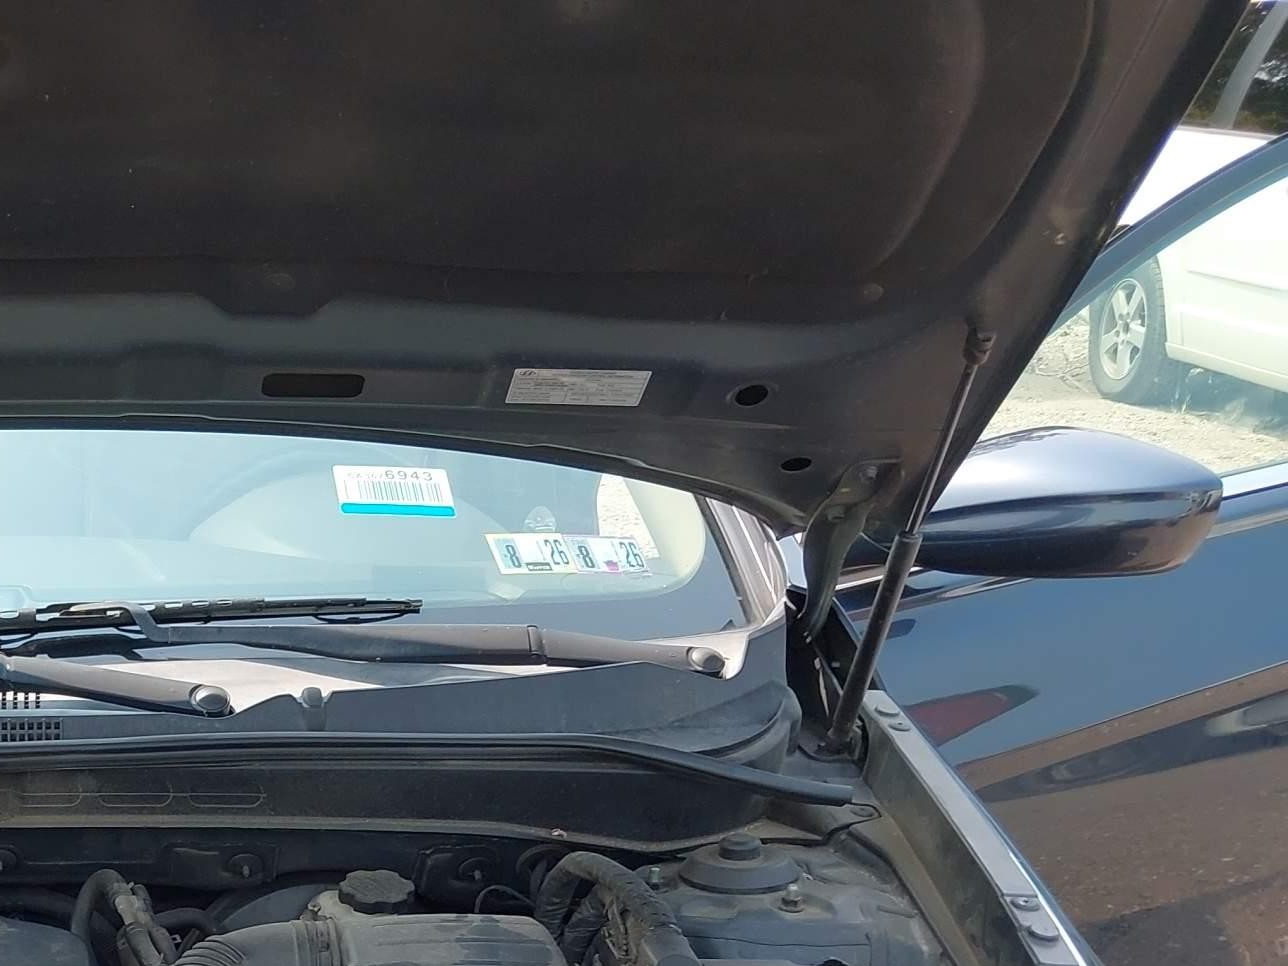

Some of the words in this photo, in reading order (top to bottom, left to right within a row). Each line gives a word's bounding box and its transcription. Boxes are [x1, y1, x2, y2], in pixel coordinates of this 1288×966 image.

[505, 545, 522, 568] 8
[544, 540, 570, 565] 26
[577, 545, 595, 568] 8
[619, 542, 645, 567] 26
